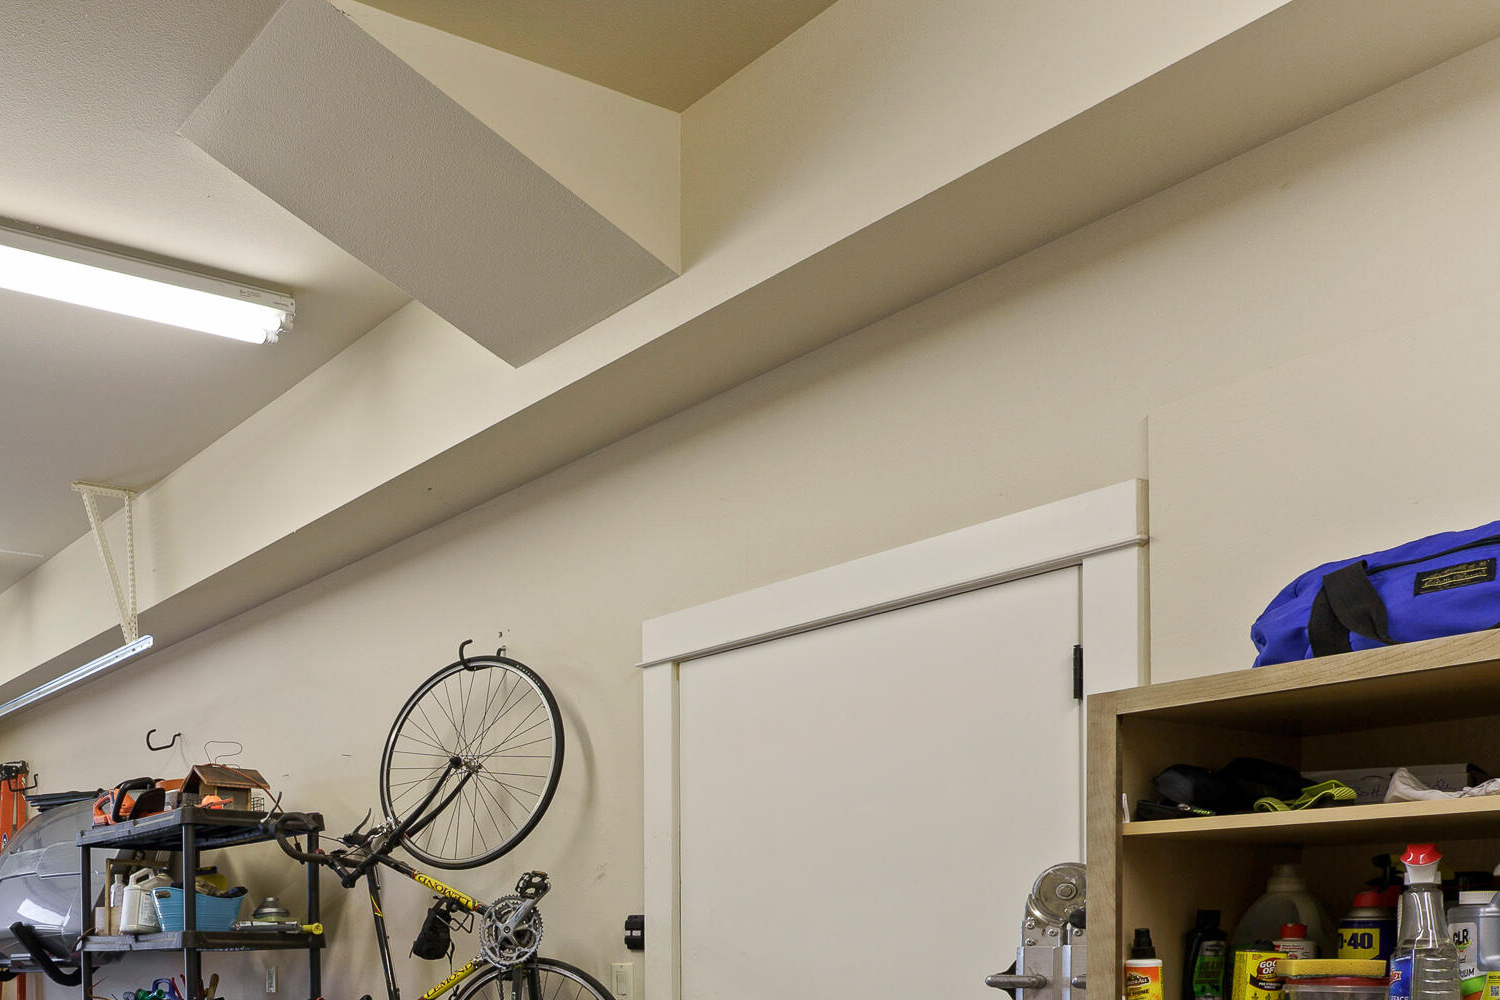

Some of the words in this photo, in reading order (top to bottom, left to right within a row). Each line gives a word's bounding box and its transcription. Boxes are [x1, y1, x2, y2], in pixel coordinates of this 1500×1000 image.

[418, 875, 470, 906] LEMOND
[1452, 928, 1469, 946] CLR
[1259, 960, 1277, 969] GOO
[1262, 967, 1277, 975] OF
[426, 961, 474, 998] LEMOND
